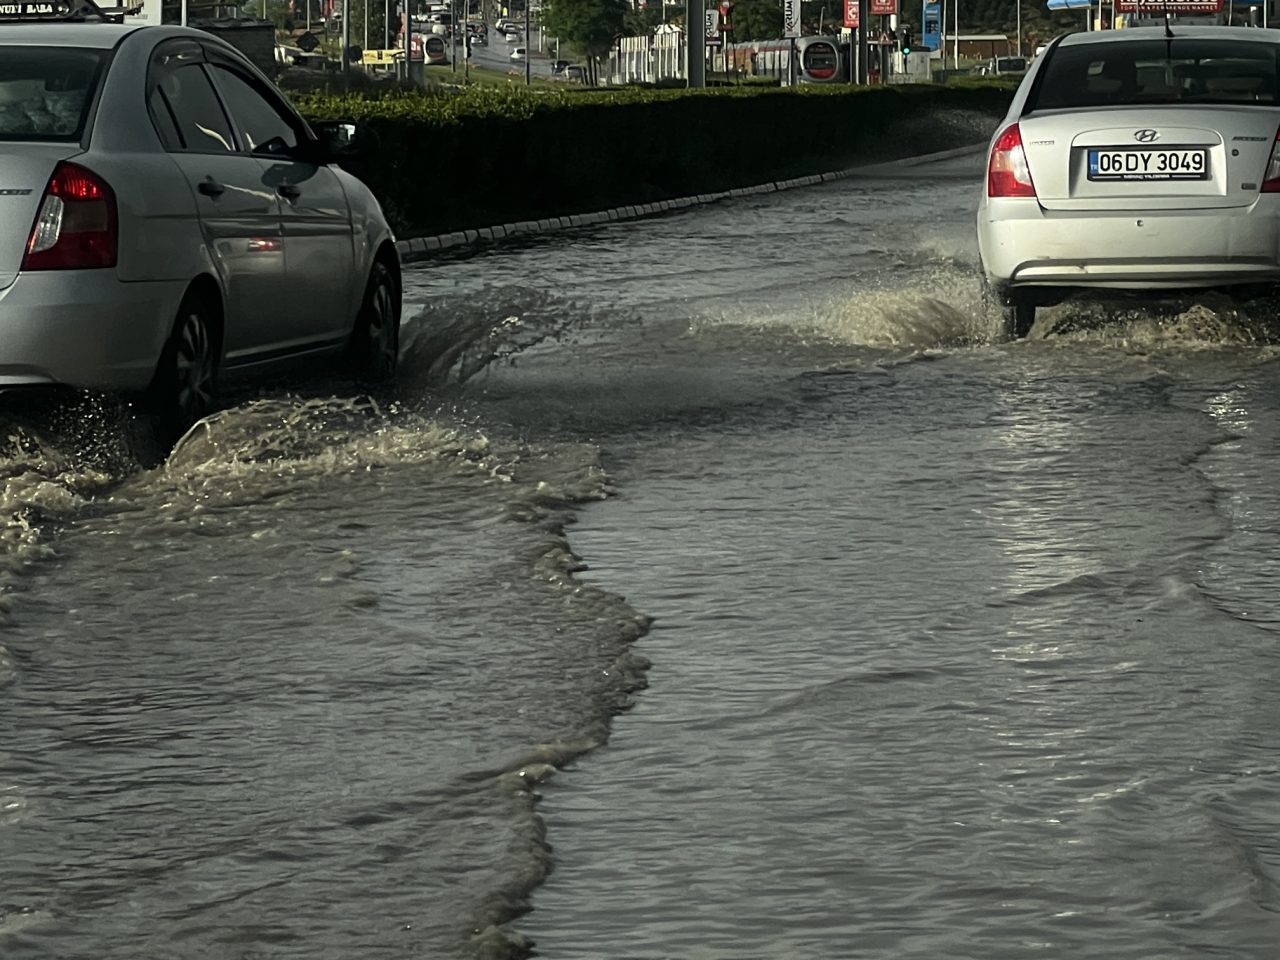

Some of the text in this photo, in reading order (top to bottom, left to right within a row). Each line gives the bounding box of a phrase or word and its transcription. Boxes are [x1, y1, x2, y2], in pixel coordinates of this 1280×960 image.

[1100, 153, 1203, 172] 06 DY 3049
